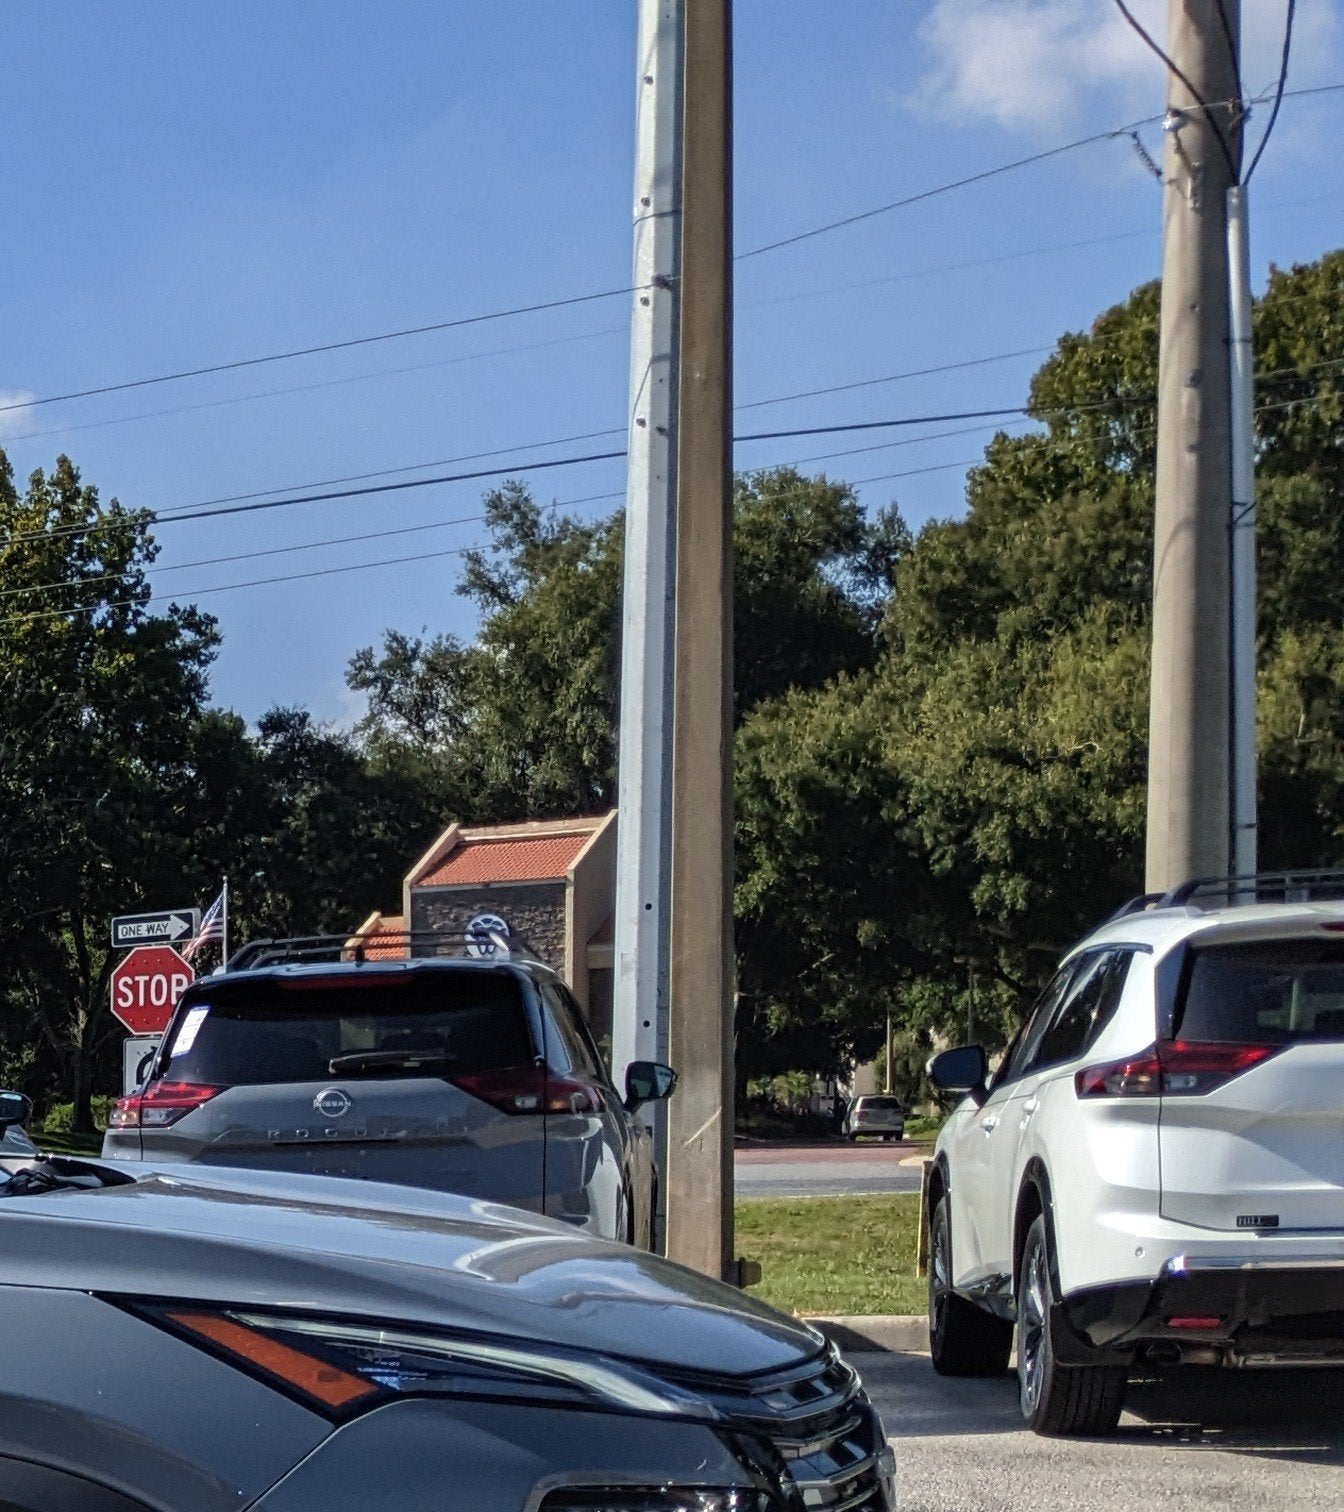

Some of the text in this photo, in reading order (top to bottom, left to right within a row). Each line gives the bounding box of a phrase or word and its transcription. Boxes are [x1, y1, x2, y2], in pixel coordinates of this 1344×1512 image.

[120, 921, 170, 938] ONE WAY
[117, 974, 188, 1008] STOP
